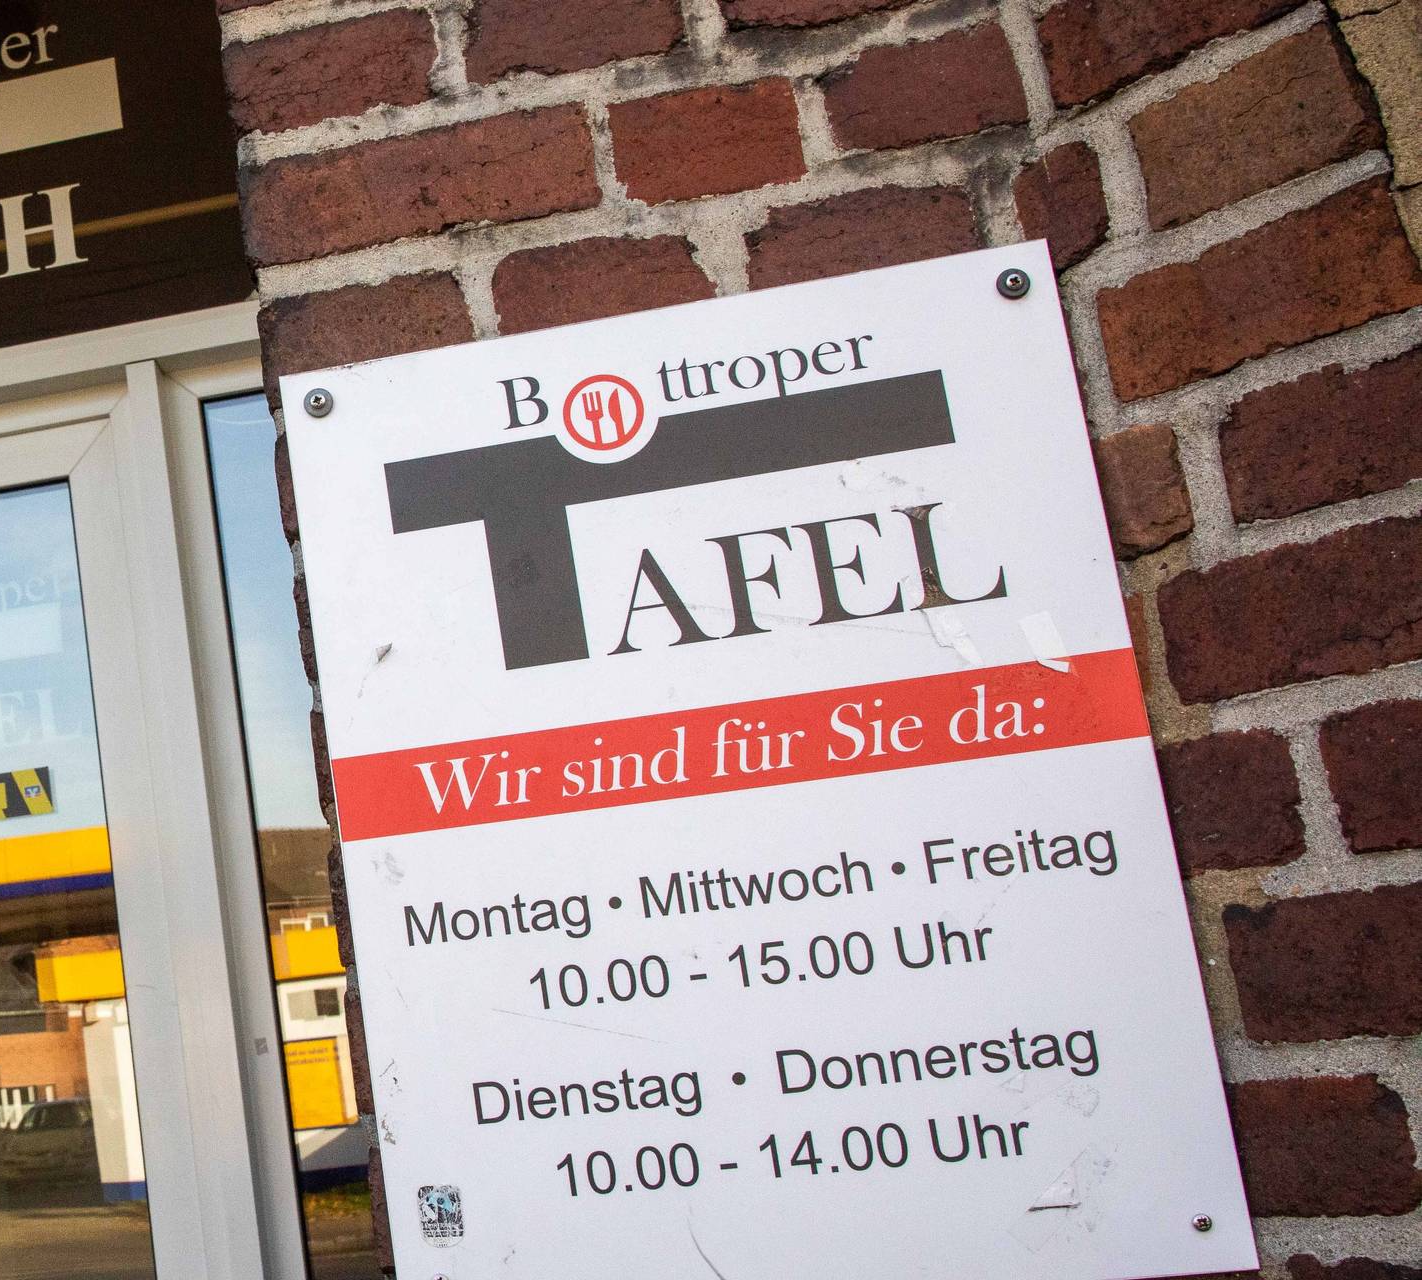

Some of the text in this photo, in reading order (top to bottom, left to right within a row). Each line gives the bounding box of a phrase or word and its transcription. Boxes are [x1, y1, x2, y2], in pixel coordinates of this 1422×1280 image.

[383, 369, 1008, 671] TAFEL
[414, 685, 1048, 814] Wir sind für Sie da:
[405, 894, 590, 947] Montag
[640, 852, 874, 918] Mittwoch
[924, 829, 1118, 884] Freitag
[529, 955, 670, 1010] 10.00
[729, 931, 874, 987] 15.00
[894, 921, 993, 969] Uhr
[473, 1068, 702, 1125] Dienstag
[776, 1027, 1099, 1094] Donnerstag
[557, 1143, 702, 1197] 10.00
[759, 1122, 908, 1178] 14.00
[928, 1112, 1029, 1163] Uhr
